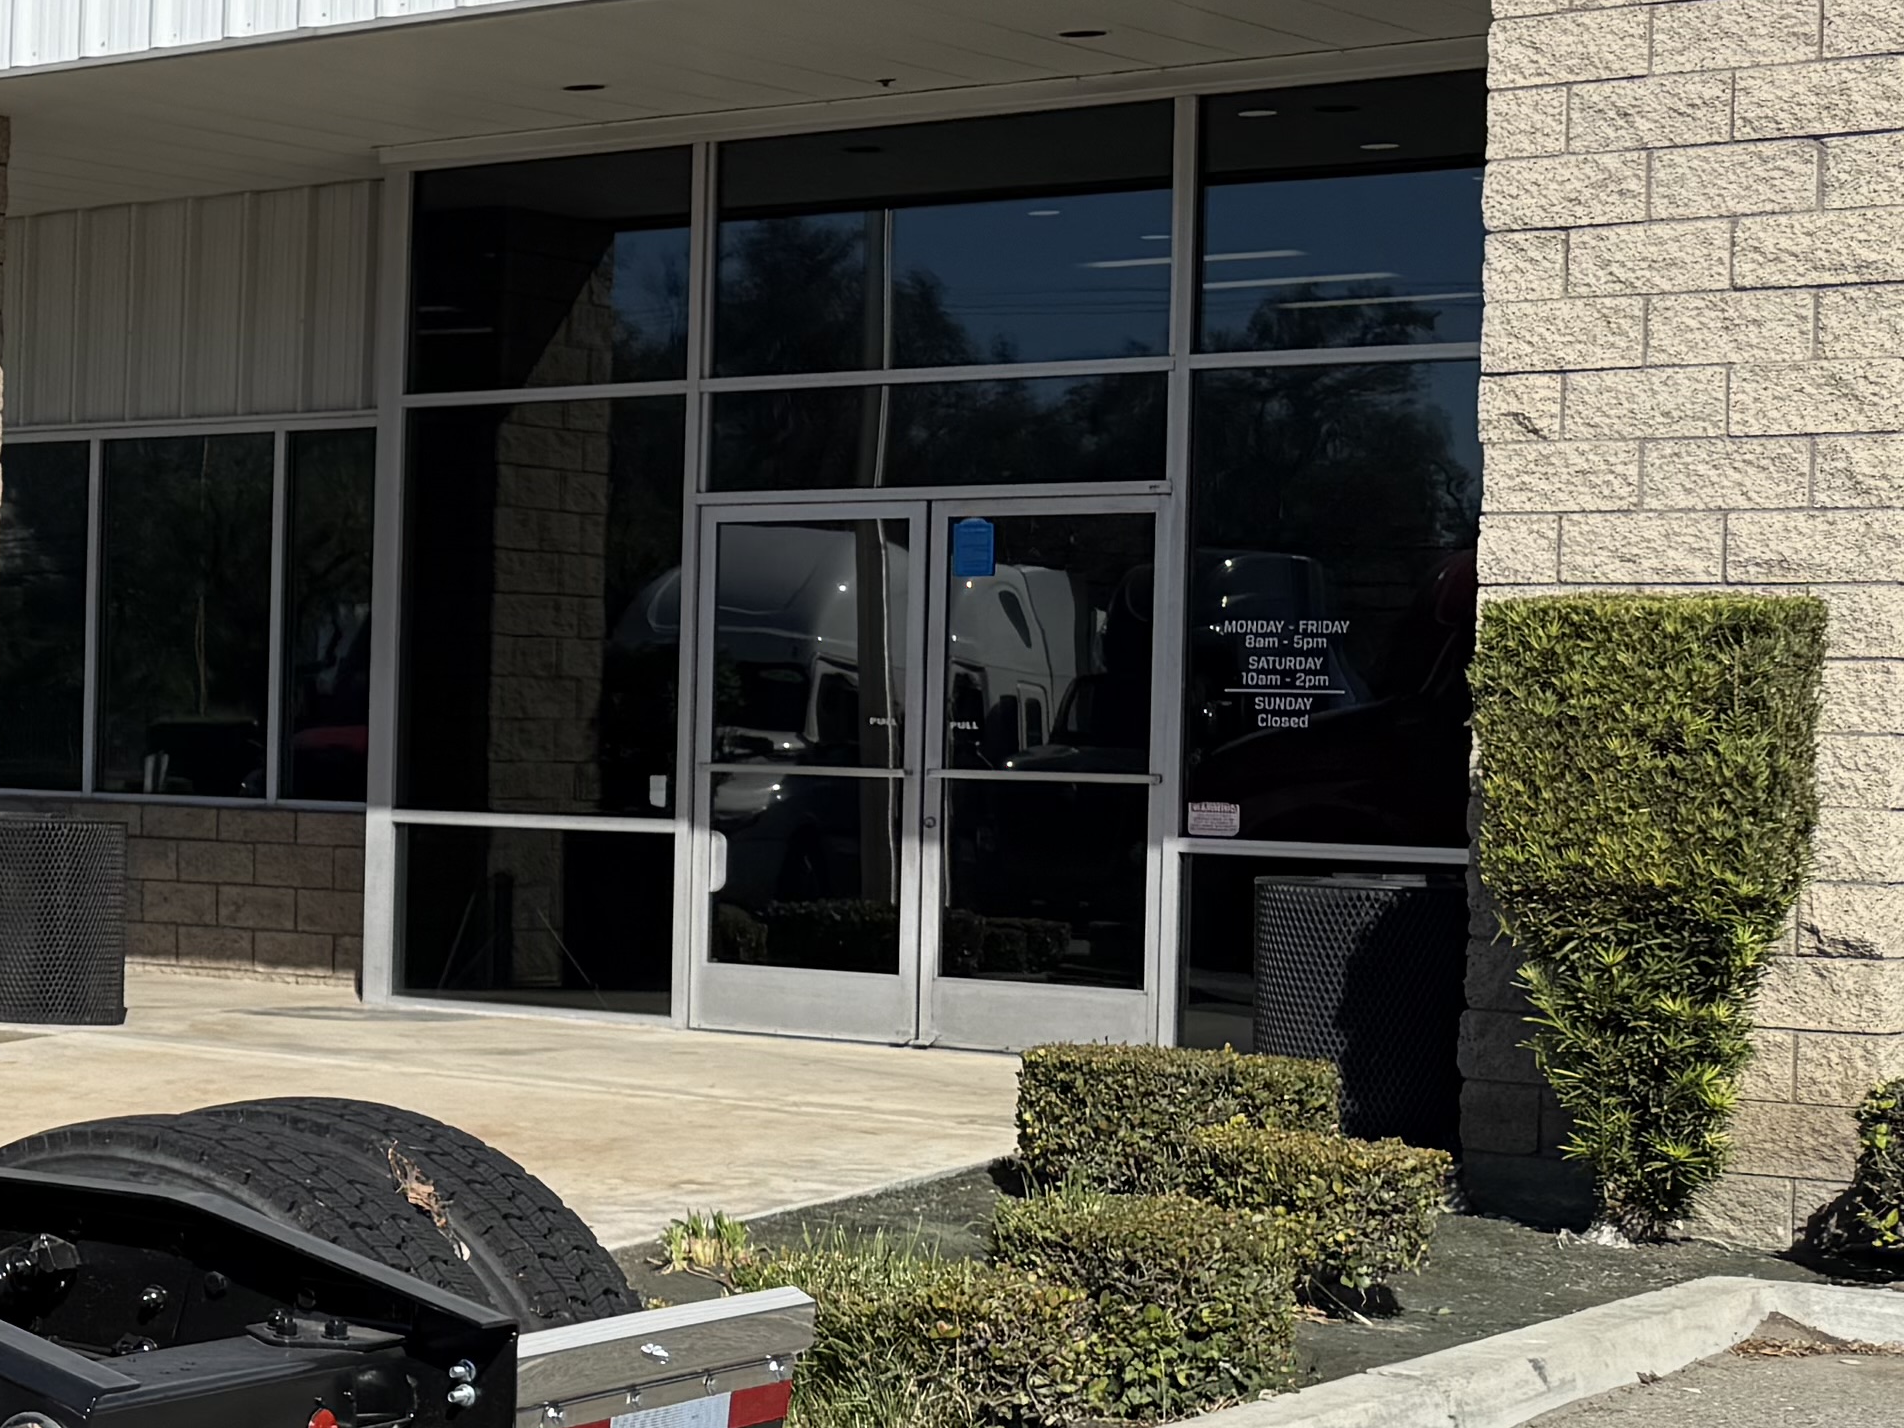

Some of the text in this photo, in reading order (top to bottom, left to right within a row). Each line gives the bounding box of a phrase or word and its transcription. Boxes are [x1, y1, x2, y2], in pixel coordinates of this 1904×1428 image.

[1223, 621, 1284, 634] MONDAY
[1299, 621, 1350, 634] FRIDAY
[1245, 635, 1278, 649] 8am
[1293, 635, 1327, 651] 5pm
[1248, 656, 1324, 670] SATURDAY
[1242, 672, 1281, 686] 10am
[1295, 673, 1329, 688] 2pm
[1255, 697, 1313, 710] SUNDAY
[950, 721, 979, 730] PULL
[1257, 714, 1309, 728] Closed
